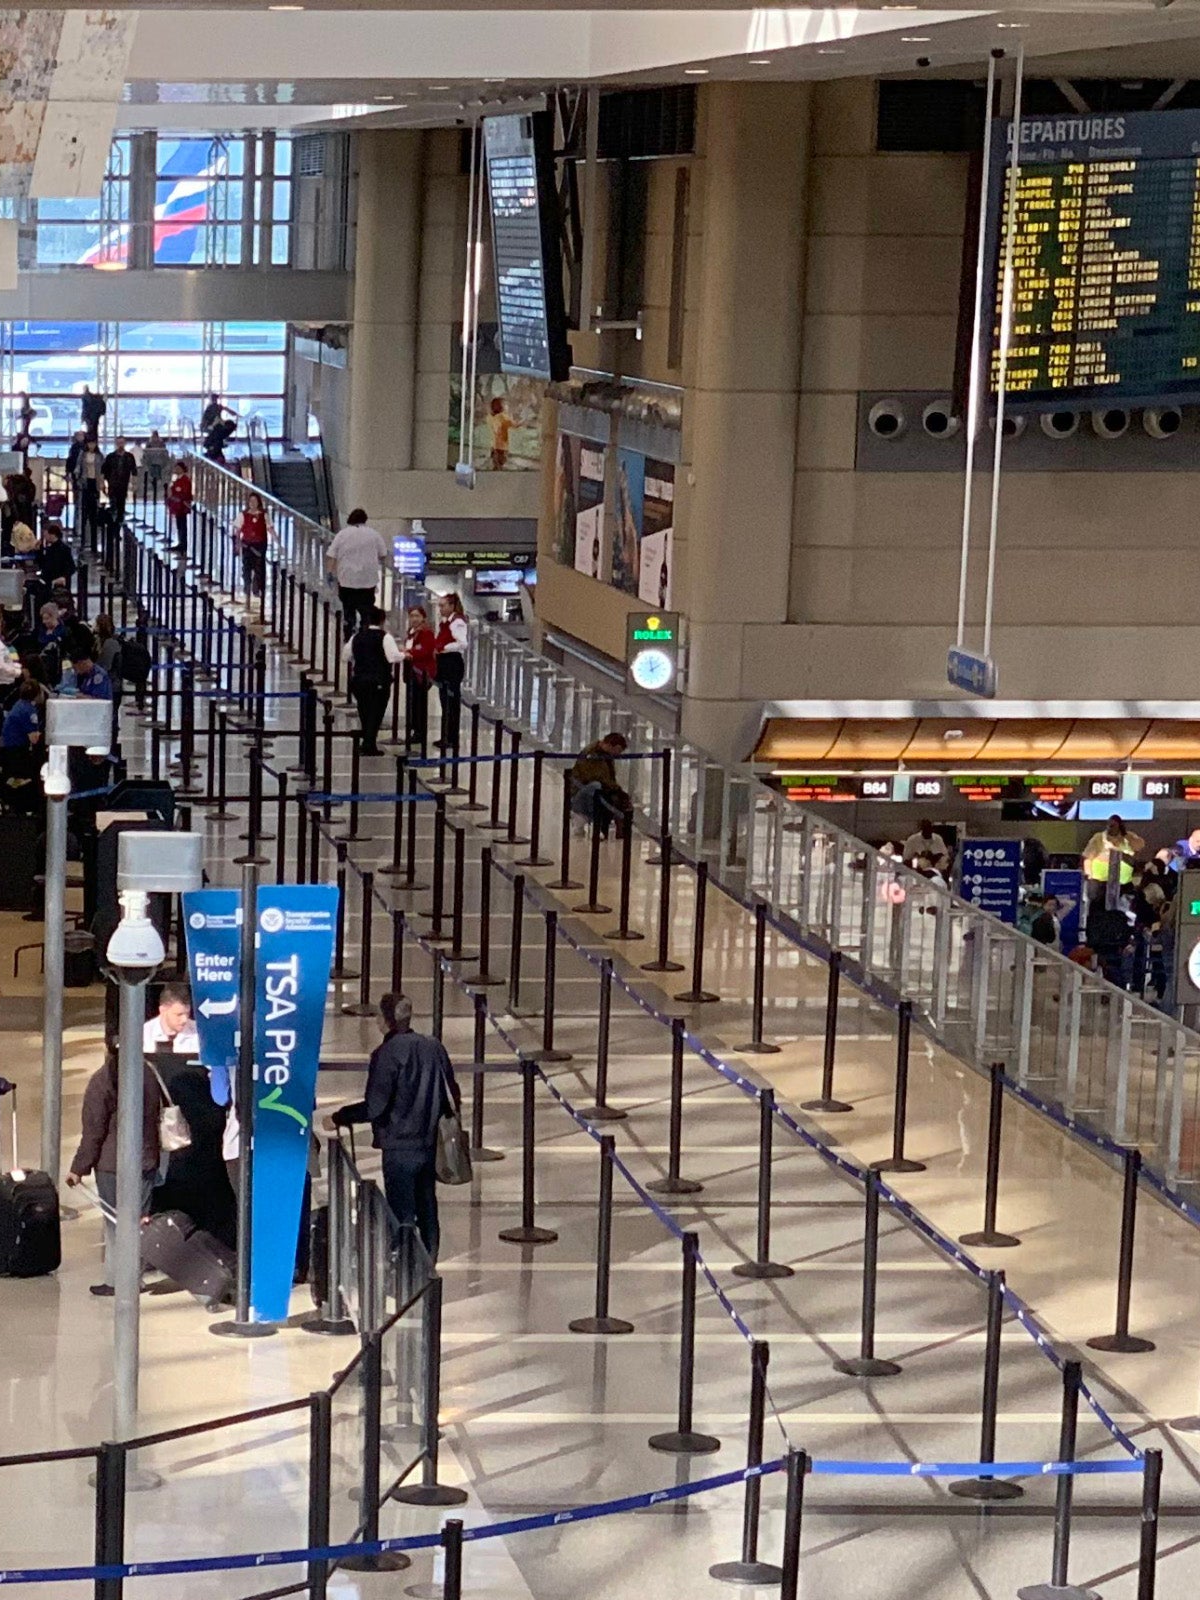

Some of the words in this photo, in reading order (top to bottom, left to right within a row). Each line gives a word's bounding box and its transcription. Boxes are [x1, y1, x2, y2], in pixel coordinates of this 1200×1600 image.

[1007, 117, 1125, 144] DEPARTURES
[1006, 168, 1022, 177] SS
[1004, 188, 1052, 200] SNGAPORE
[1088, 184, 1134, 195] SINGAPORE
[1084, 218, 1132, 228] FRANKFURT
[1081, 264, 1113, 274] LONDON
[1117, 261, 1159, 272] HEATHROW
[1080, 275, 1112, 286] LONDON
[1116, 272, 1158, 283] HEATHROW
[1079, 298, 1110, 308] LONDON
[1115, 295, 1156, 306] HEATHROW
[634, 630, 672, 640] ROLEX
[863, 782, 887, 794] B64
[916, 782, 940, 795] B63
[1092, 783, 1116, 794] B62
[1146, 783, 1169, 794] B61
[195, 952, 234, 966] Enter
[197, 968, 232, 982] Here
[265, 954, 298, 1021] TSA
[265, 1031, 296, 1086] Pre
